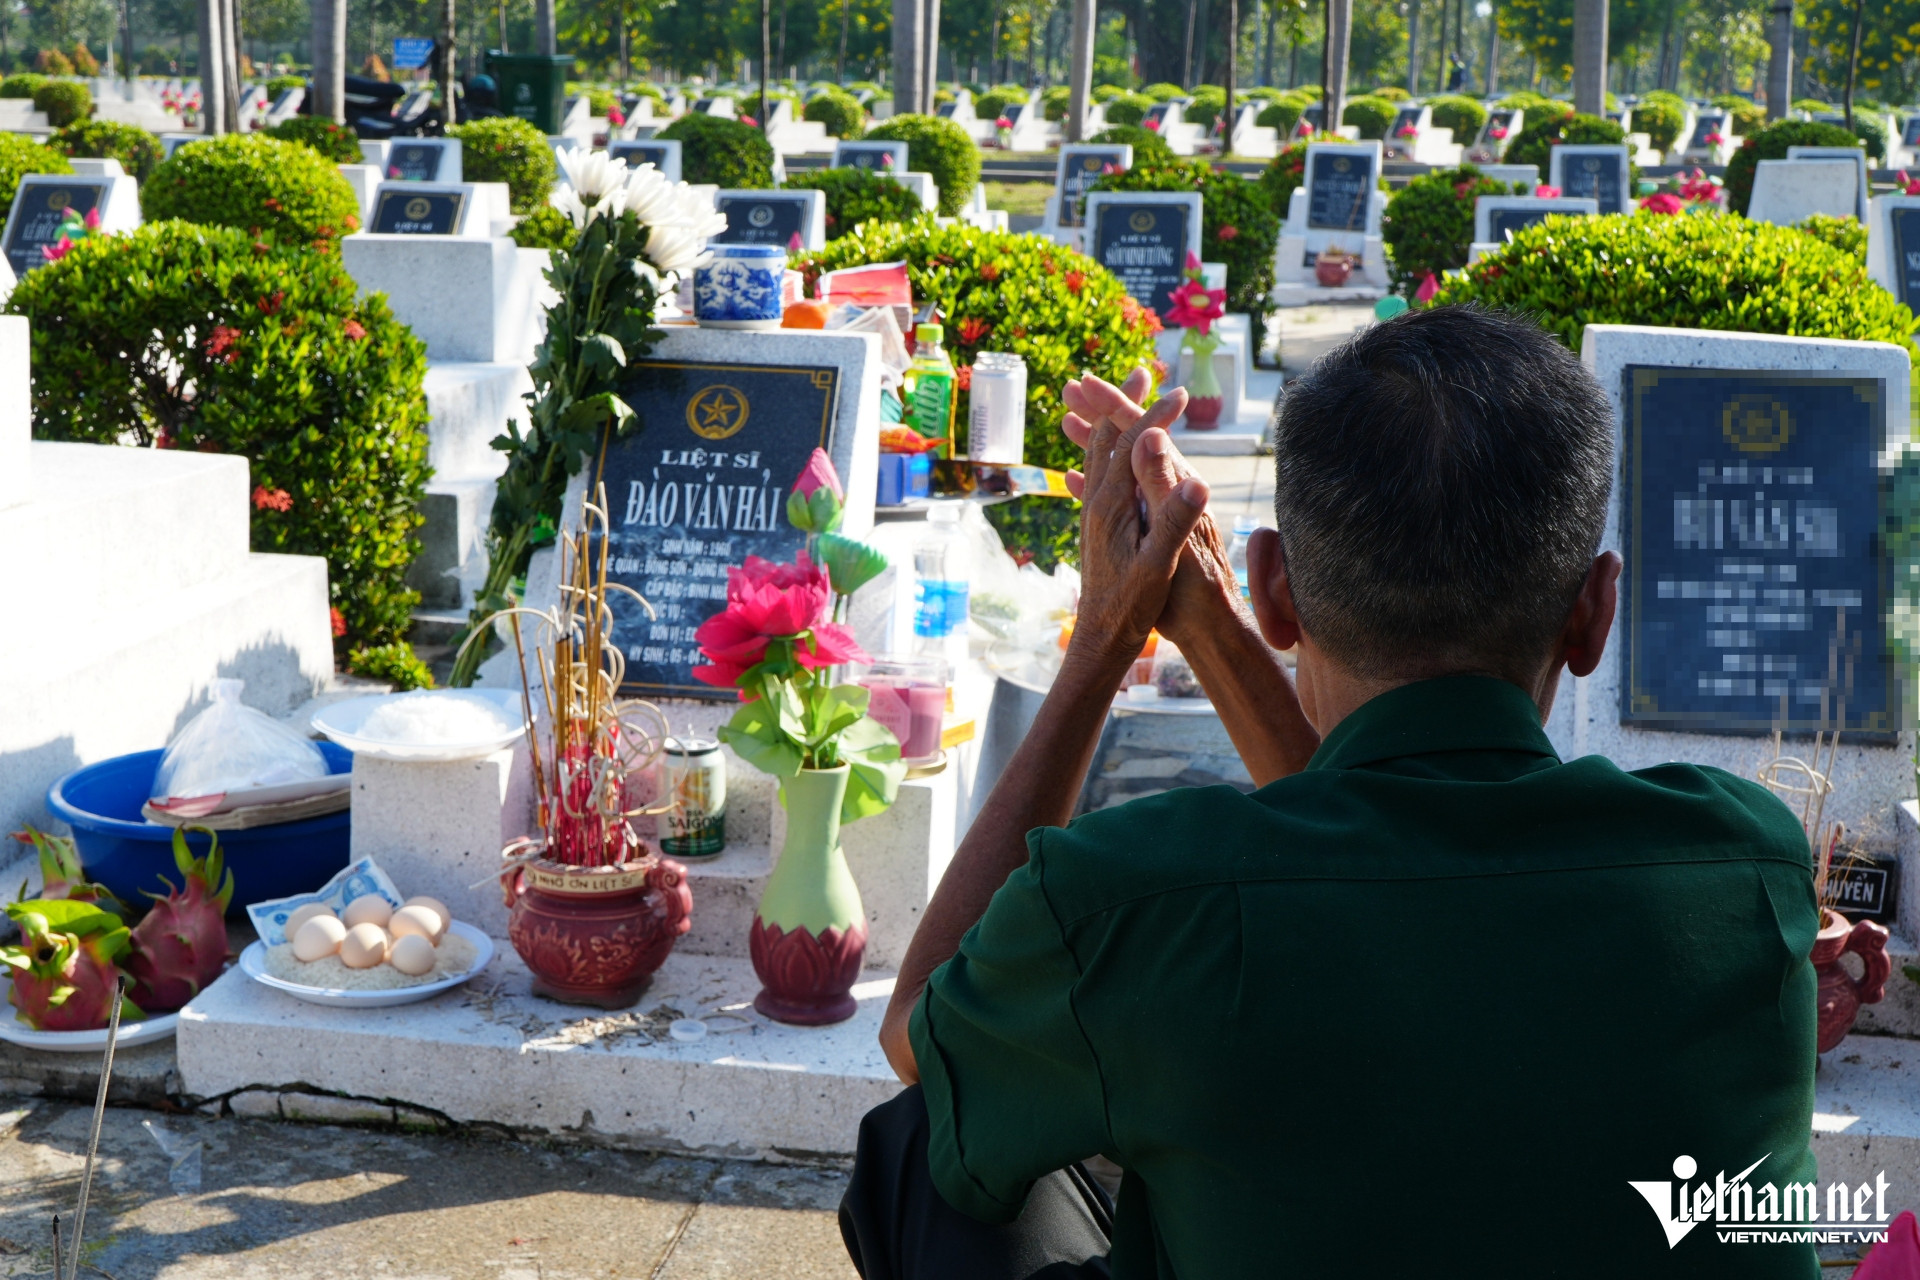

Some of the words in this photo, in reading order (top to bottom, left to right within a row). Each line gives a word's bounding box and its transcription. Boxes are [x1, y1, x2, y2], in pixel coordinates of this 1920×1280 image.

[660, 448, 729, 469] LIỆT
[733, 451, 762, 469] SĨ
[623, 466, 679, 528] ĐÀO
[684, 472, 734, 531] VĂN
[733, 468, 782, 532] HẢI
